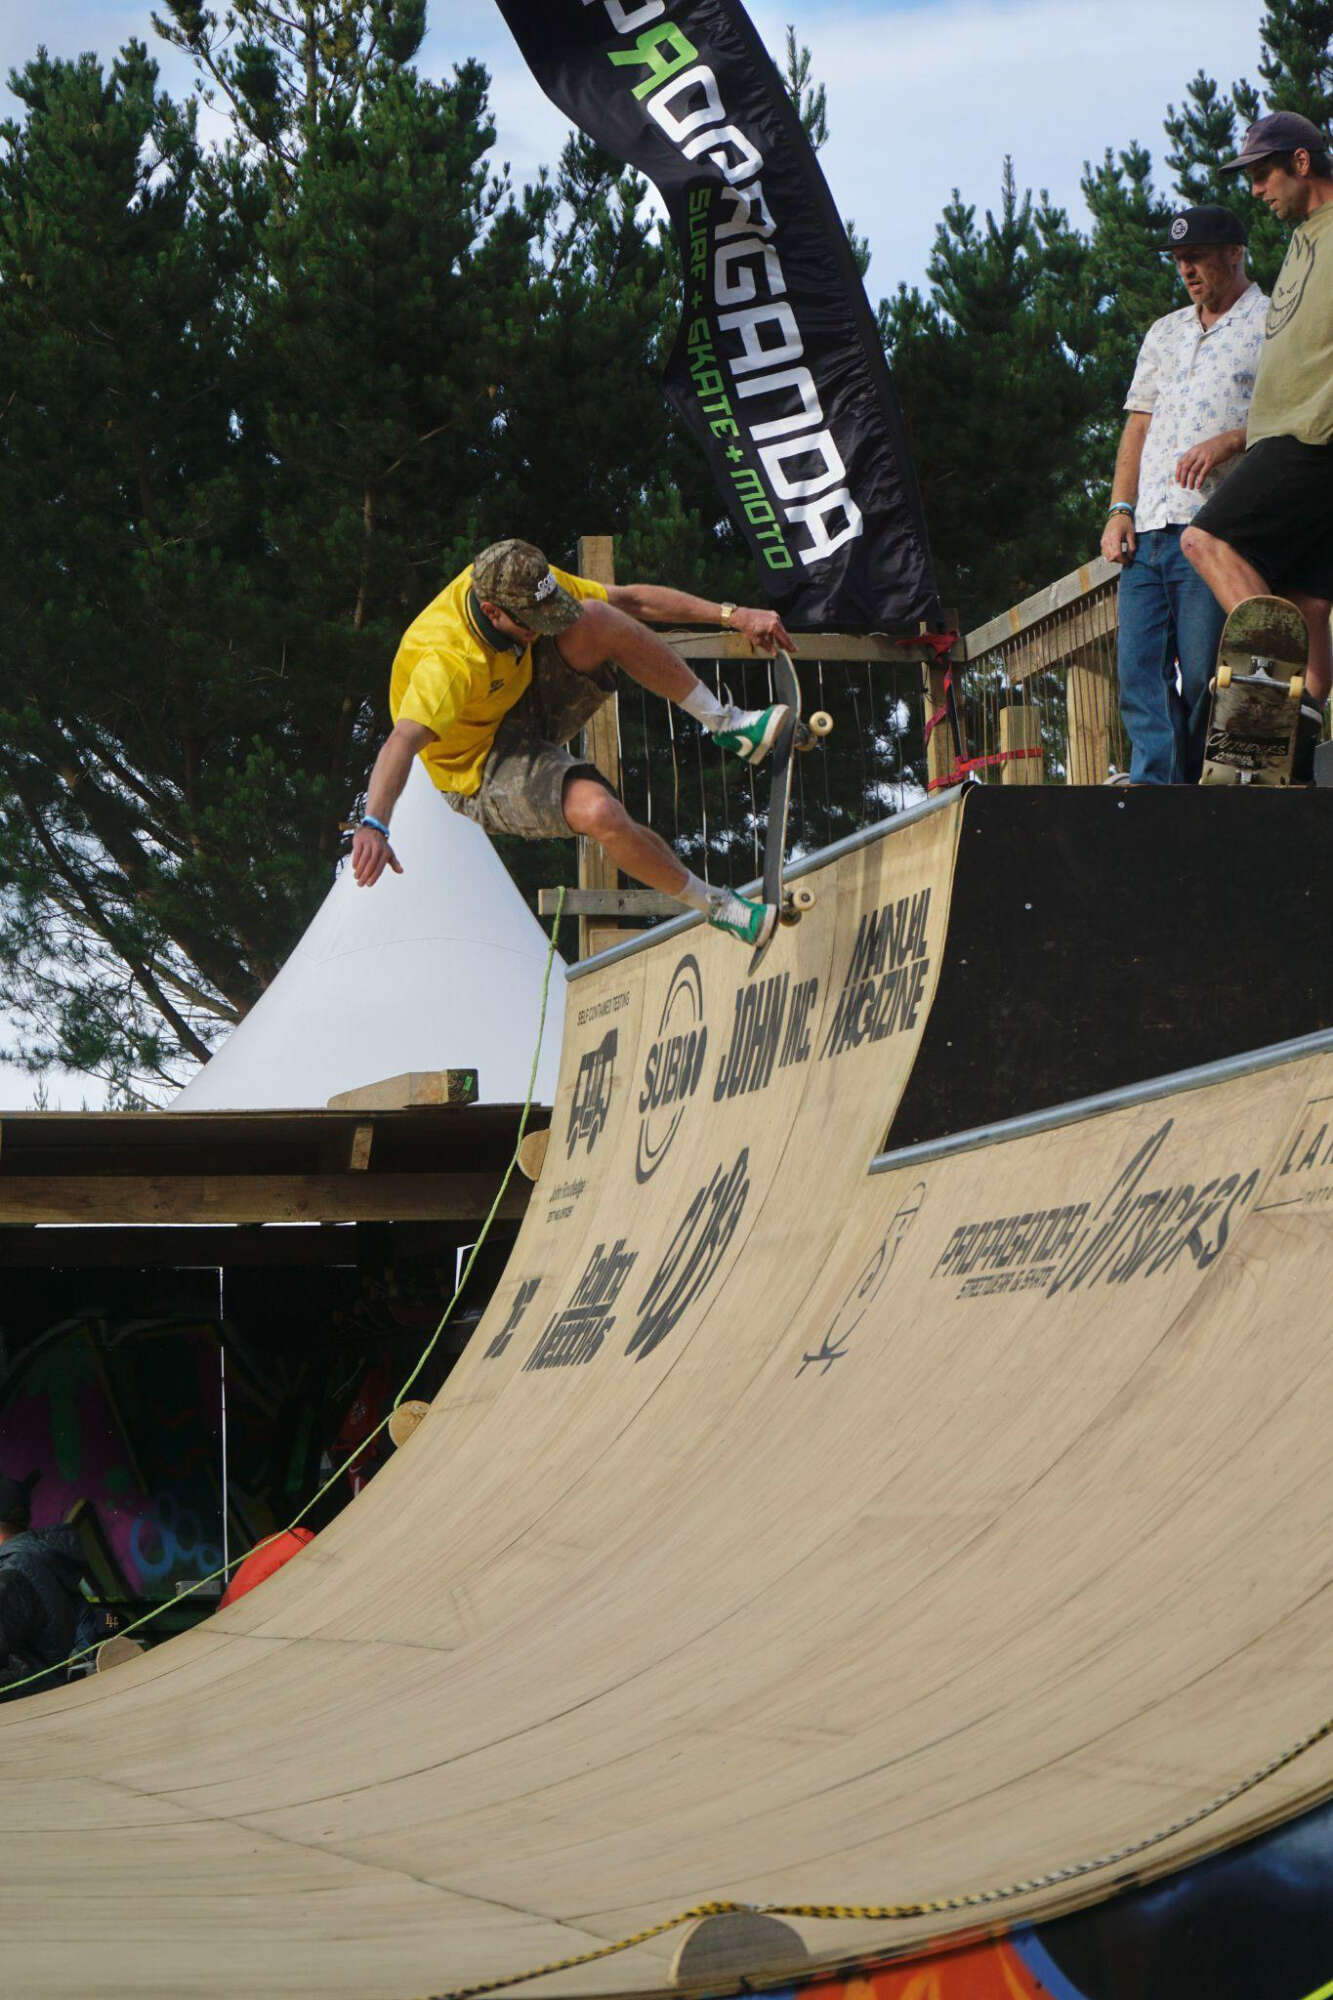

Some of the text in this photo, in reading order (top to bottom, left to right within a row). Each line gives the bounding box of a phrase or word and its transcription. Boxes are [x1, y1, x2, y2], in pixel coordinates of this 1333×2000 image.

[687, 187, 712, 281] SURF
[687, 317, 739, 438] SKATE
[731, 470, 794, 571] MOTO
[844, 887, 932, 987] MANUAL
[713, 972, 790, 1103] JOHN
[818, 958, 930, 1061] MAGAZINE
[931, 1202, 1091, 1279] PROPAGANDA
